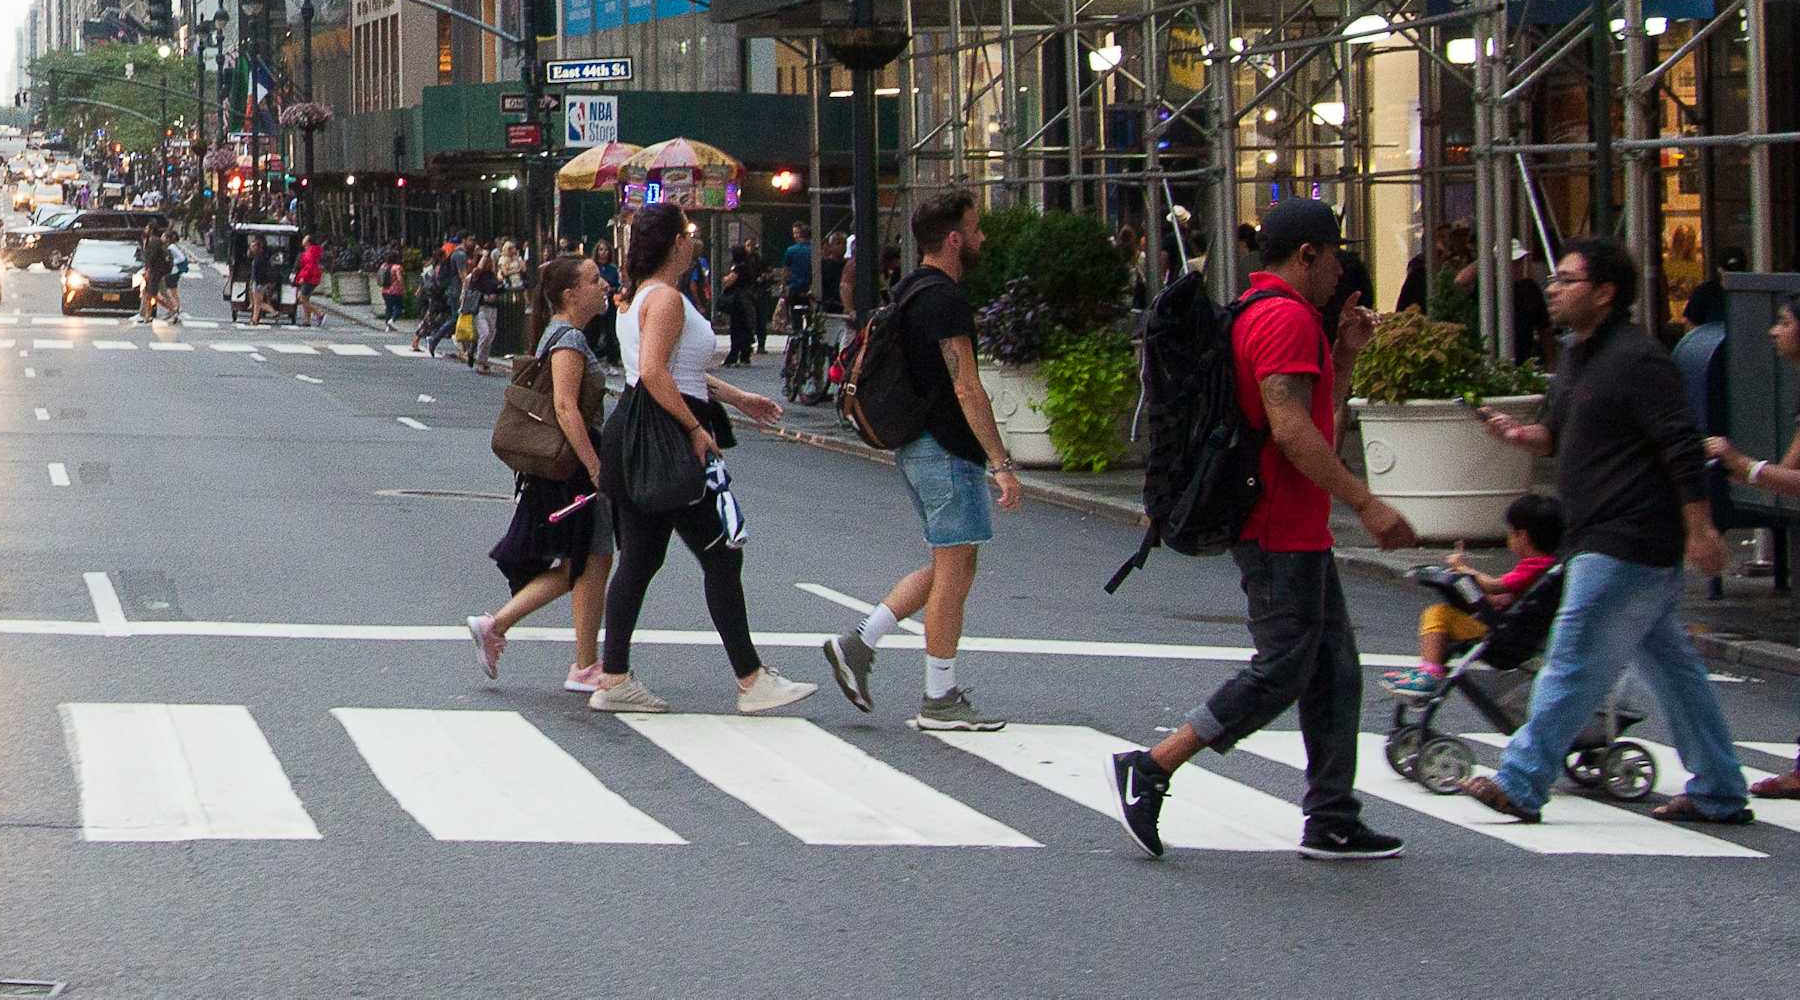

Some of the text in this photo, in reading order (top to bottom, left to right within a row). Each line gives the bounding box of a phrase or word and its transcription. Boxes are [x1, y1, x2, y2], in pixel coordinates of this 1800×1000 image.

[552, 63, 626, 79] East 44th St
[589, 101, 613, 121] NBA
[589, 122, 616, 142] Store
